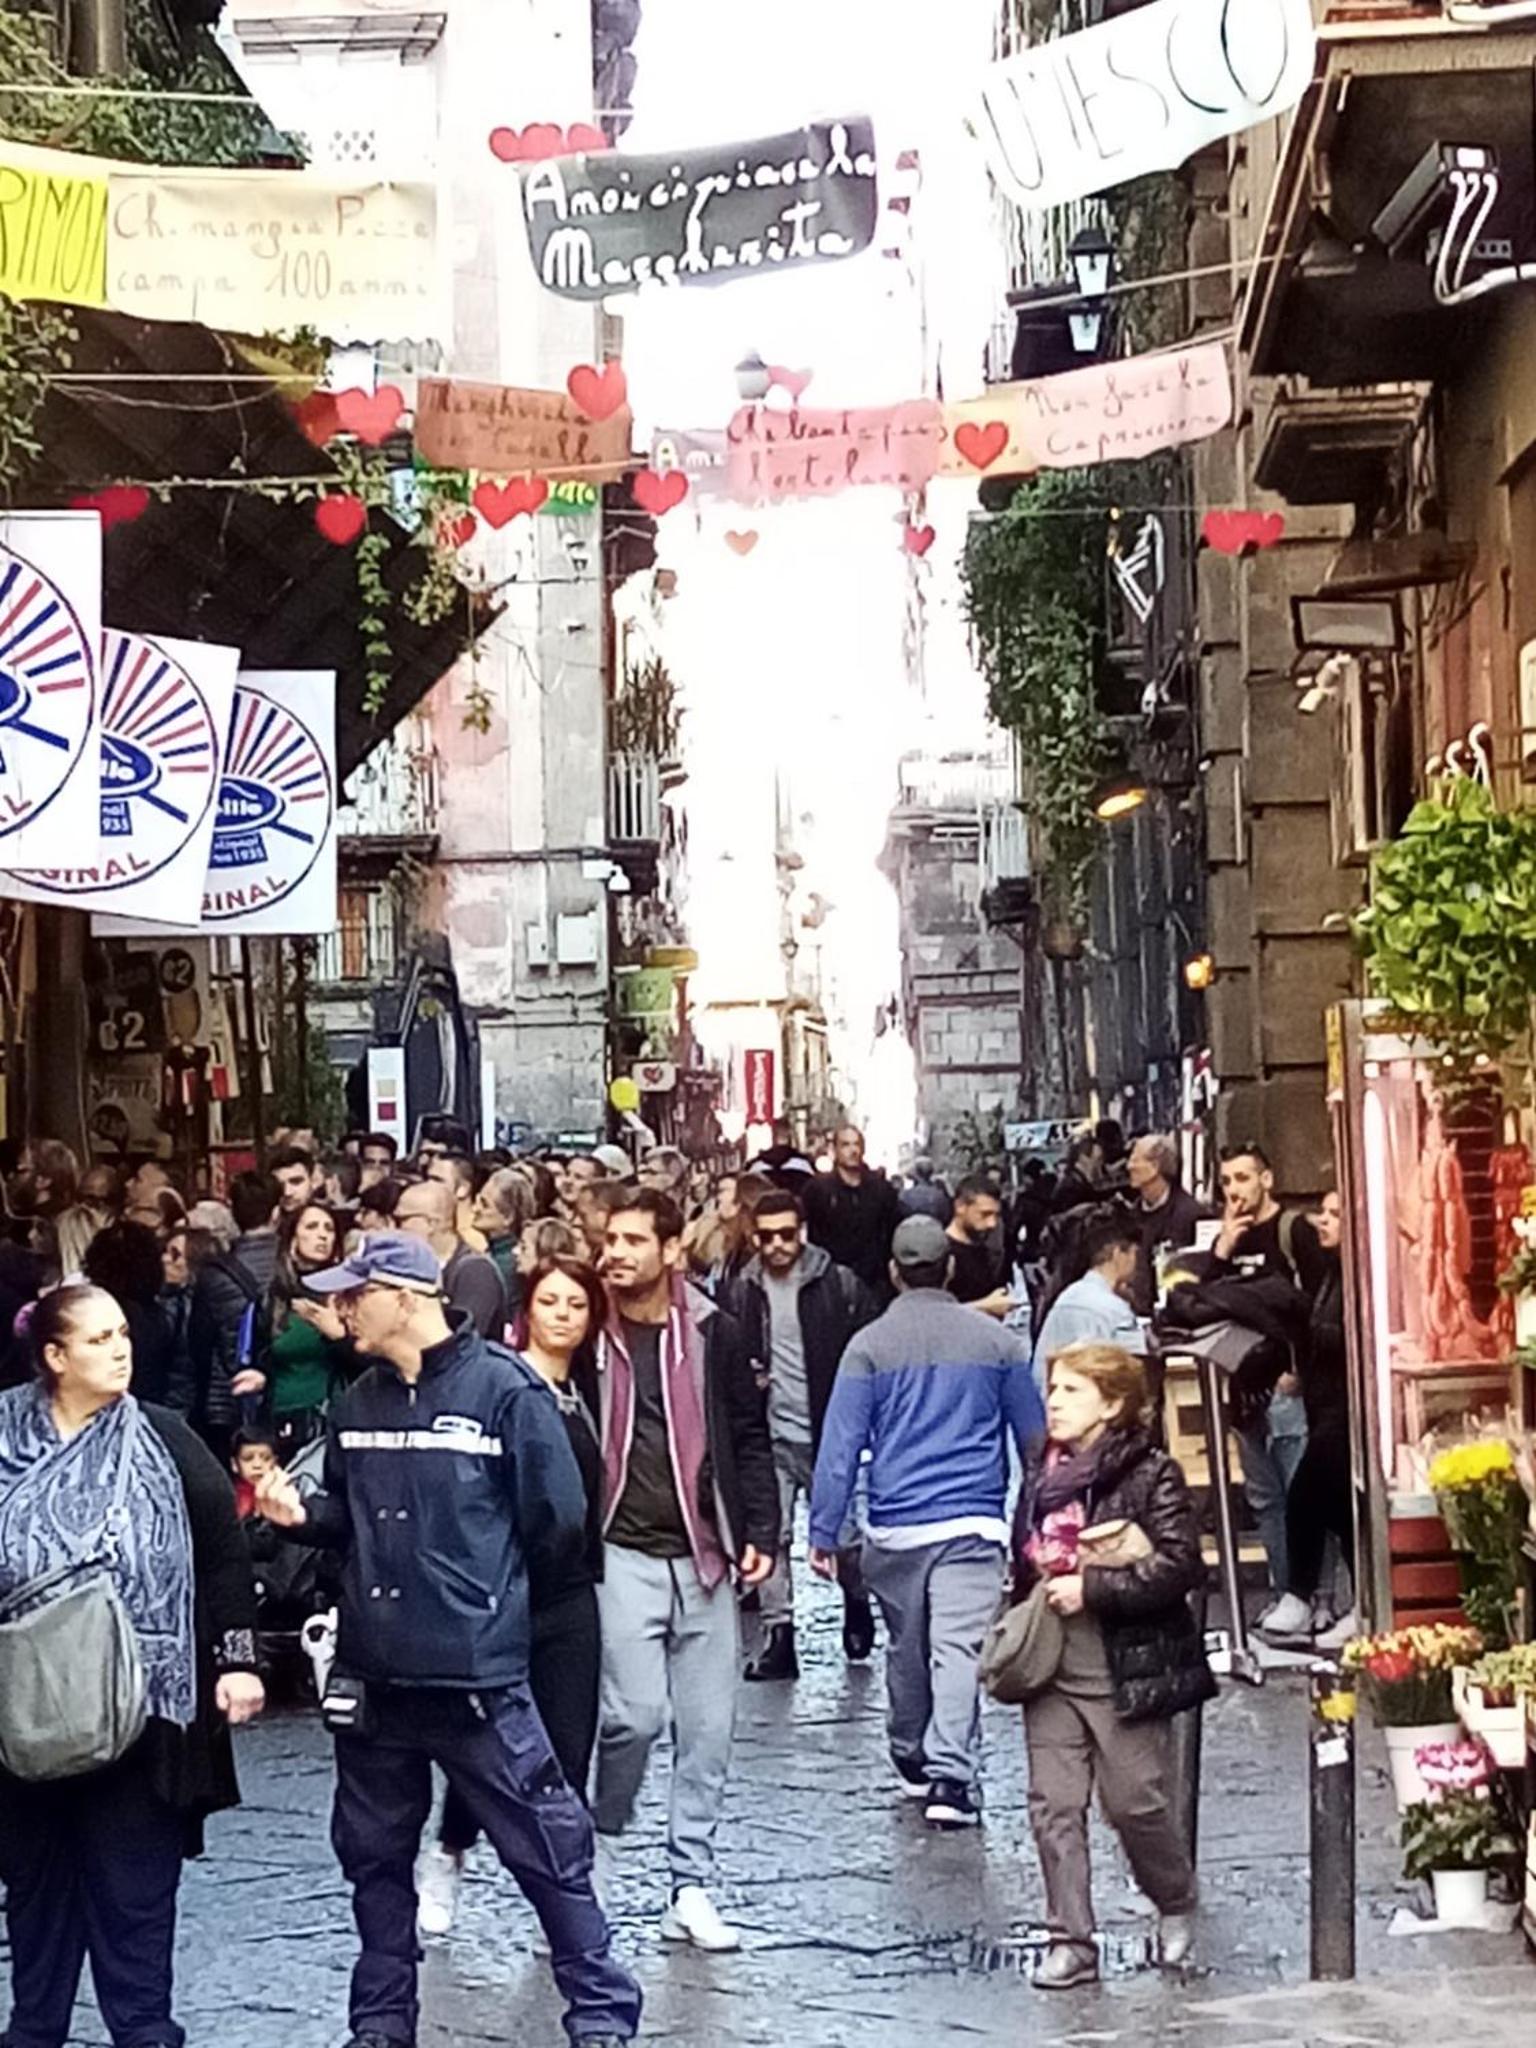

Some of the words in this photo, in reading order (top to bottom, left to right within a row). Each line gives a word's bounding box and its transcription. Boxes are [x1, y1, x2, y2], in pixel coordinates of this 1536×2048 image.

[543, 200, 854, 287] Margherita
[117, 271, 237, 319] campa
[264, 249, 332, 301] 100
